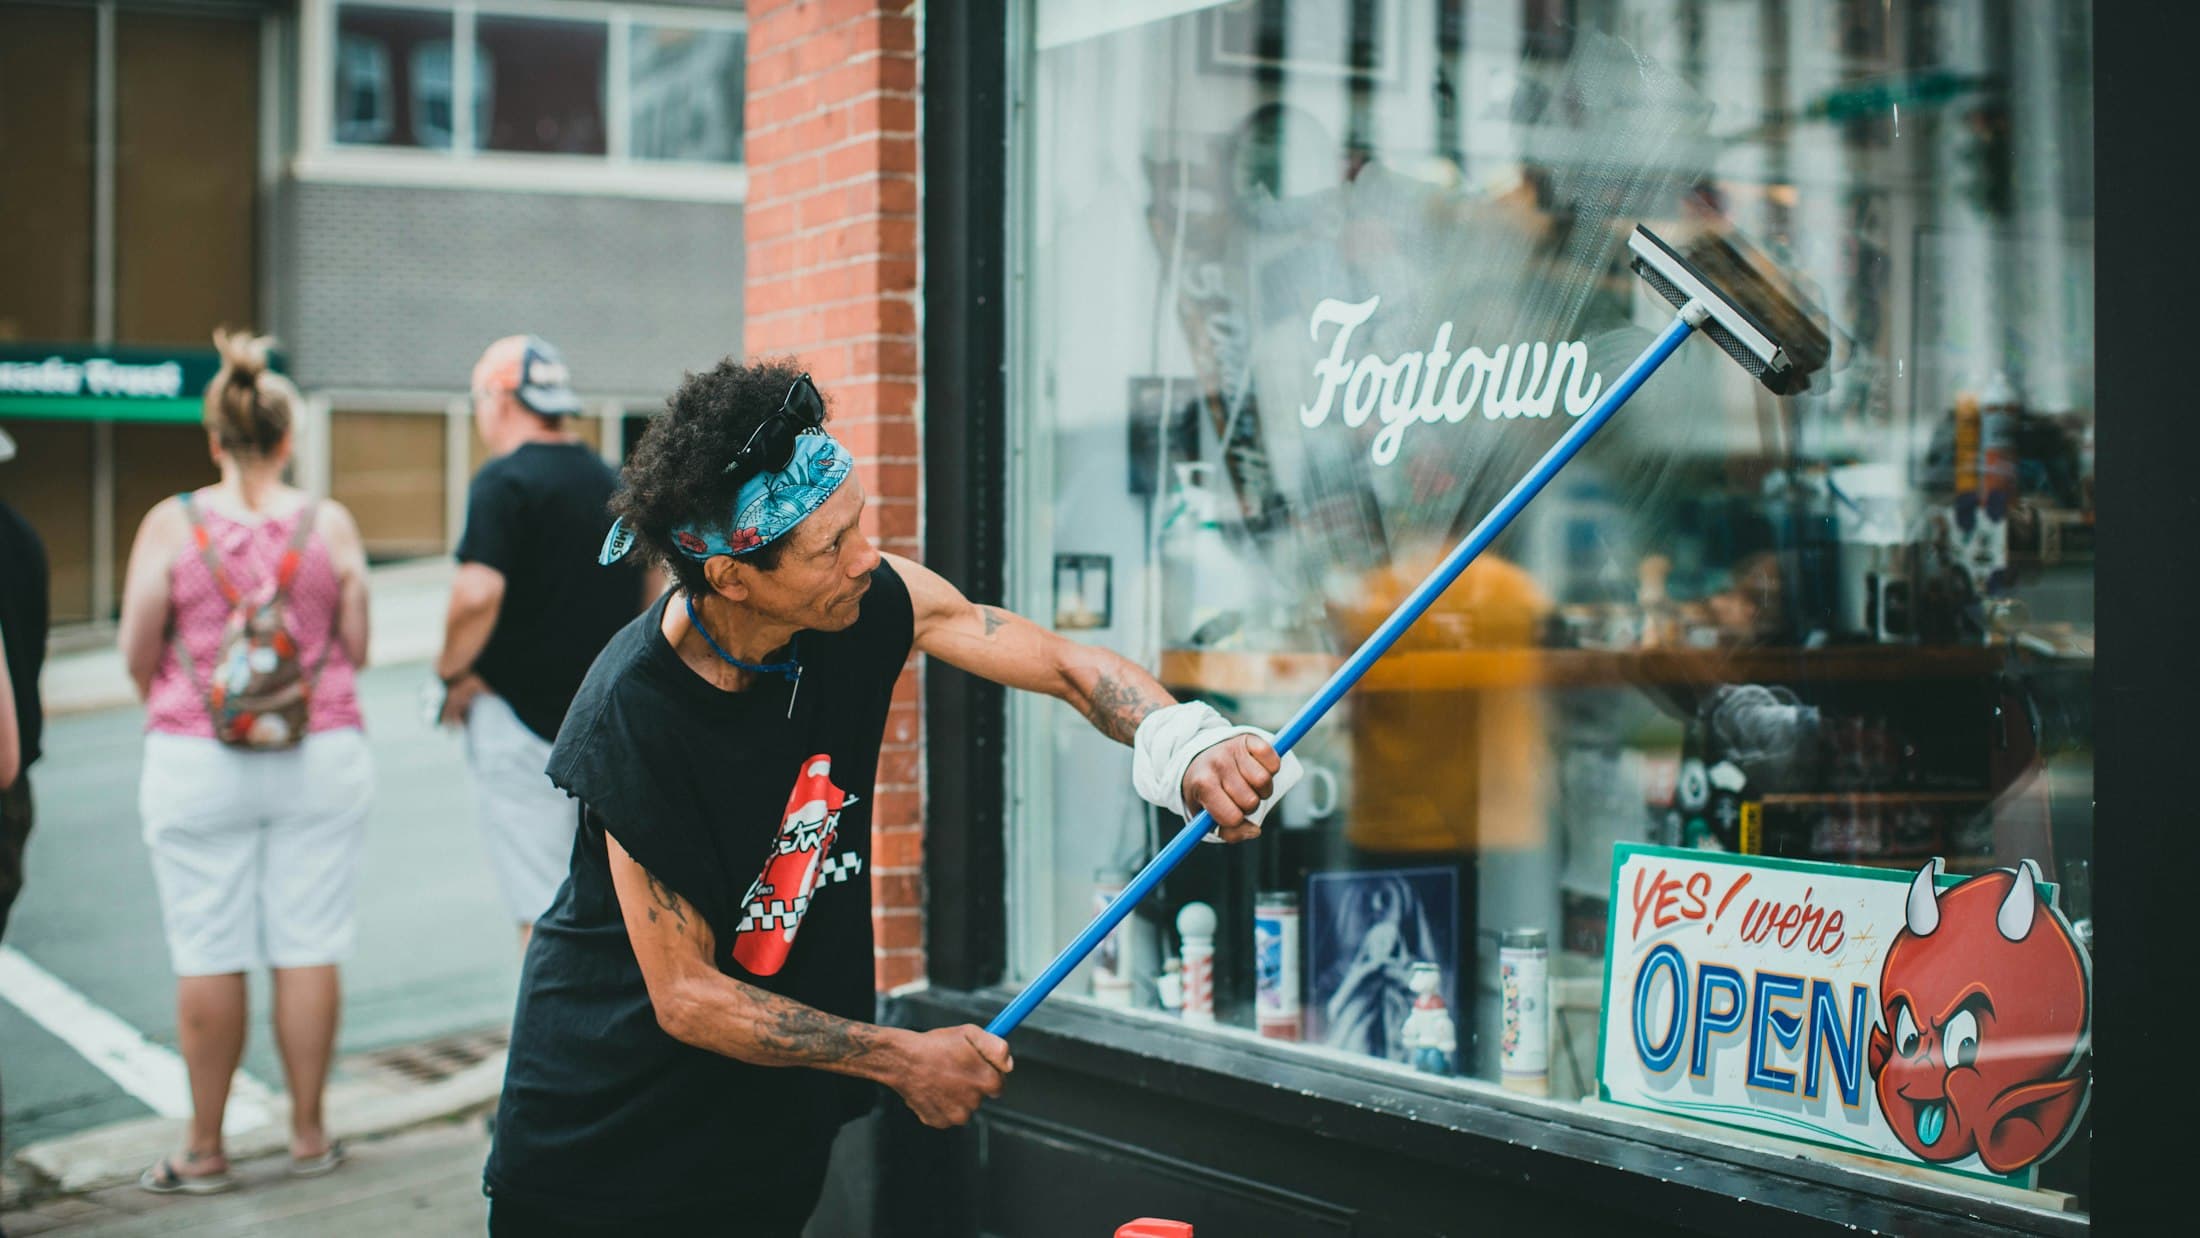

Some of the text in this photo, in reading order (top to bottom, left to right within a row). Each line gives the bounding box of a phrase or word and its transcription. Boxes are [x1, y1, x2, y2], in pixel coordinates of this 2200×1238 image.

[84, 358, 182, 397] Trust
[1299, 295, 1602, 466] Fogtown
[1633, 867, 1844, 954] YES! we're
[1632, 941, 1870, 1110] OPEN
